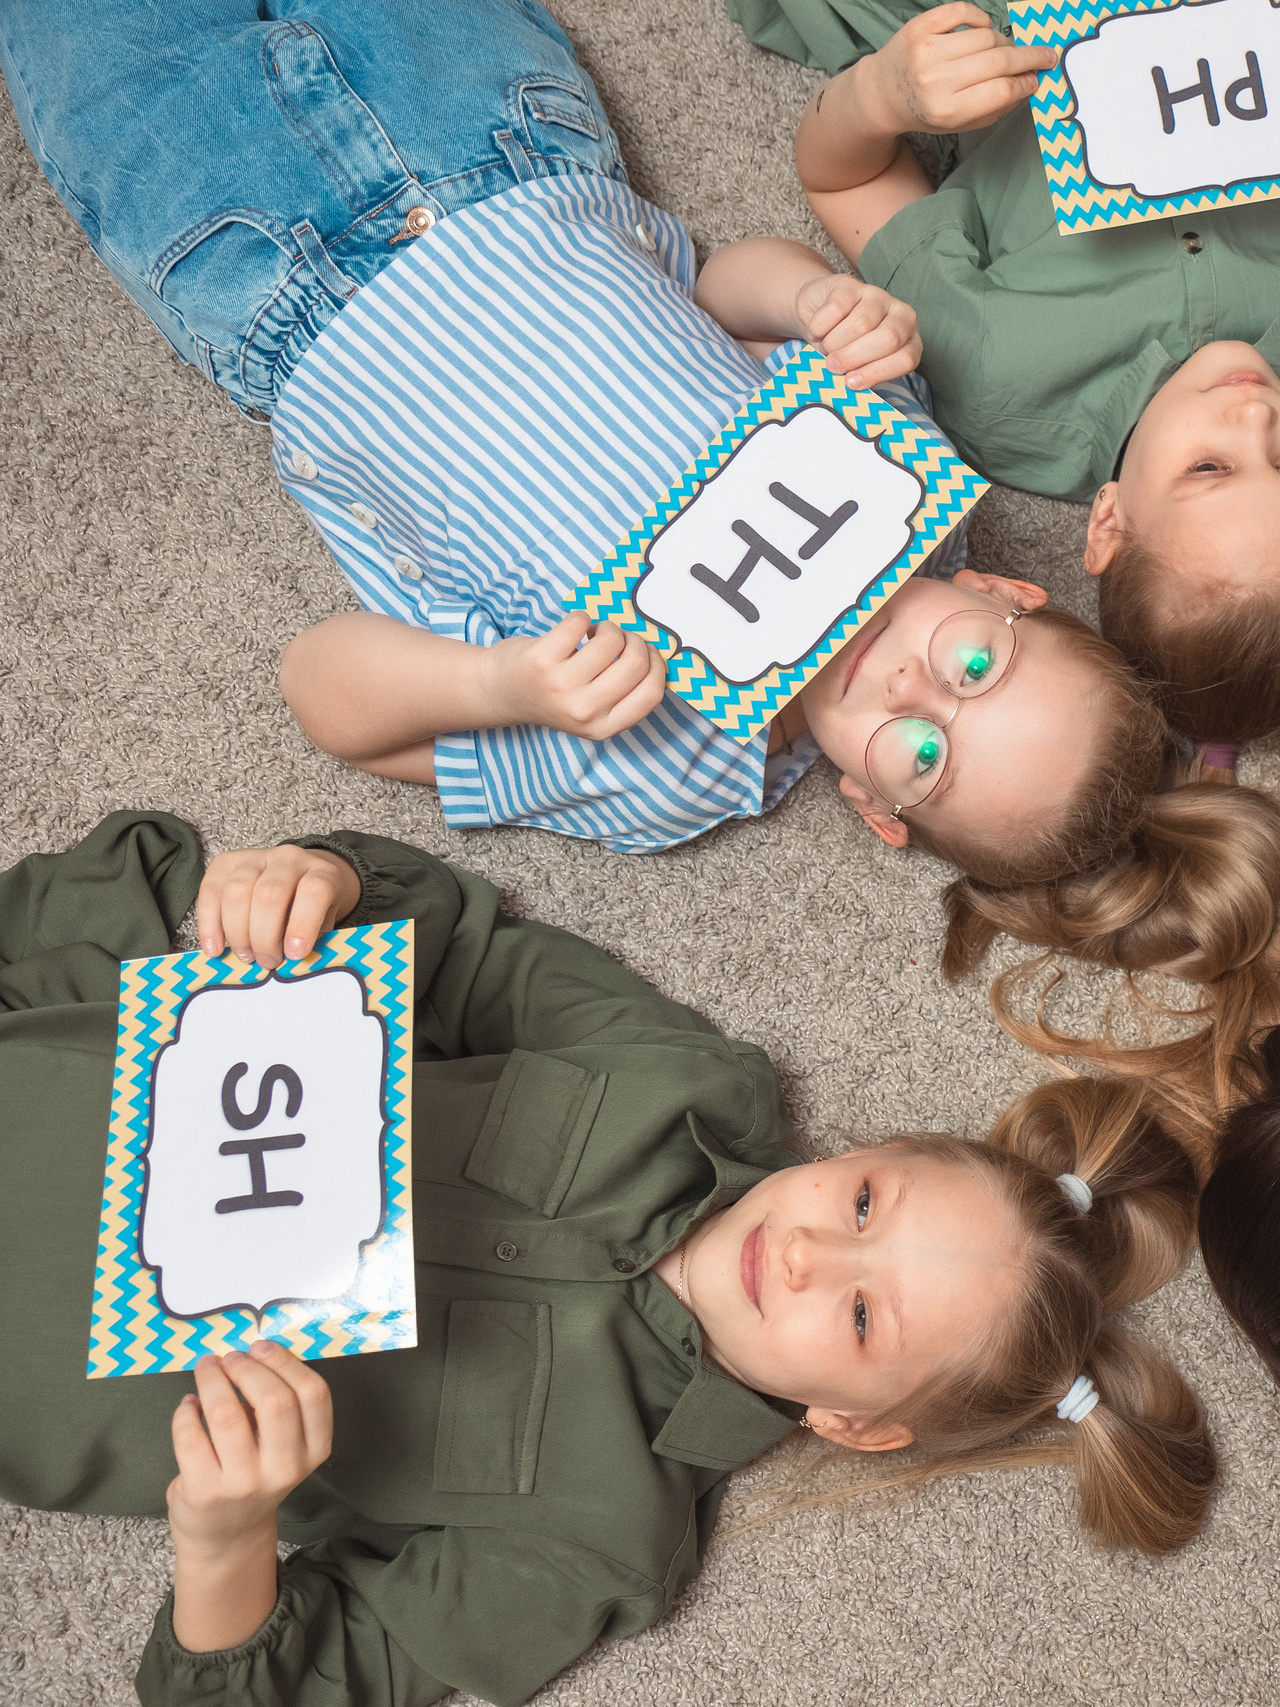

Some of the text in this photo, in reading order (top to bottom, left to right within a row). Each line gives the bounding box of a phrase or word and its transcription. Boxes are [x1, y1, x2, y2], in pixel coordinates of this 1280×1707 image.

[1150, 50, 1268, 135] PH
[689, 481, 859, 624] TH
[214, 1061, 306, 1215] SH
